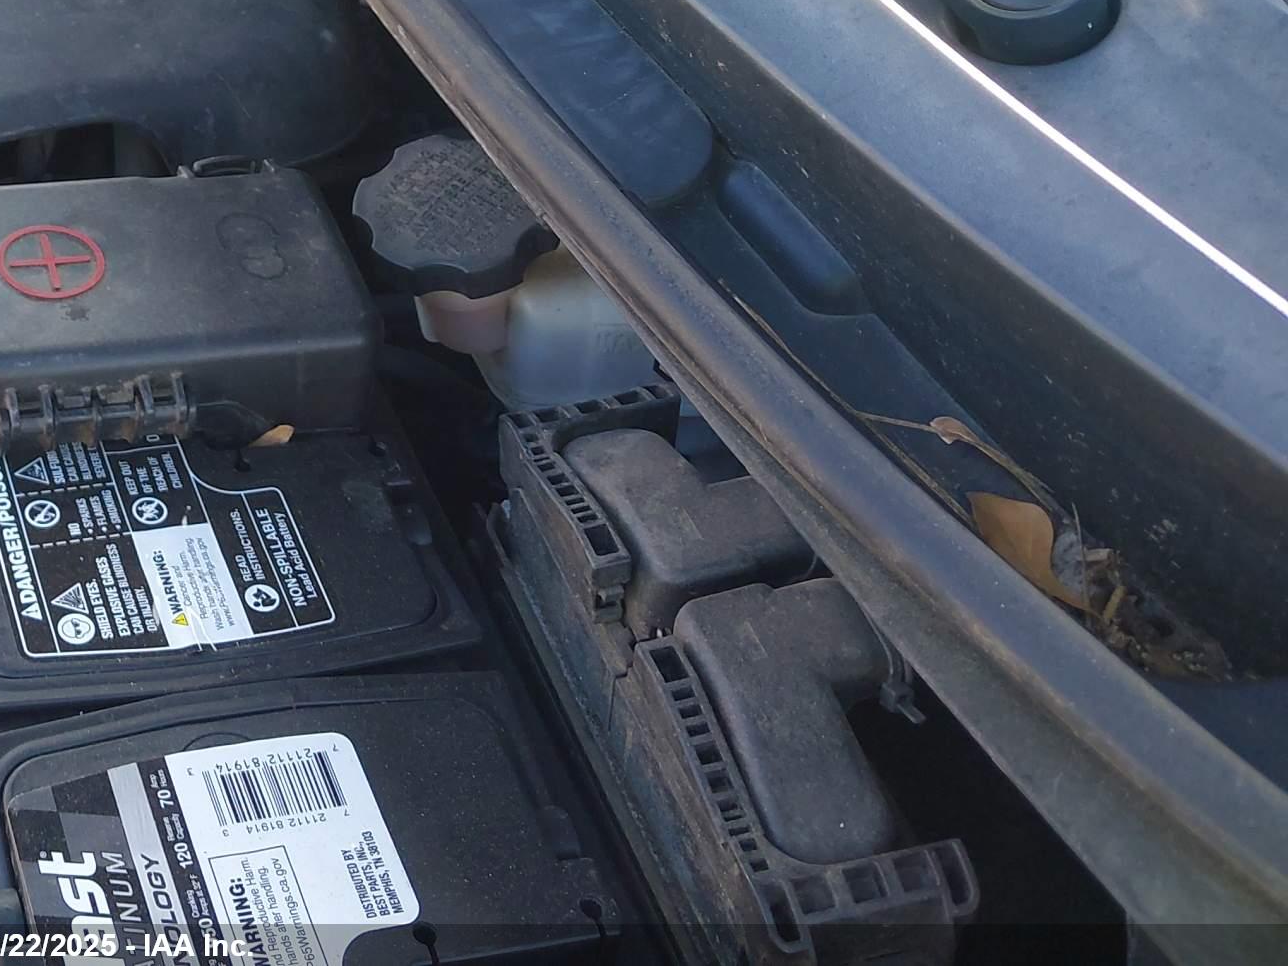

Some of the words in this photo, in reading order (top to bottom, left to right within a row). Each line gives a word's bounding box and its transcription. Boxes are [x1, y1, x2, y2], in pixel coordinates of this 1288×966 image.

[118, 460, 132, 476] OUT
[136, 466, 149, 483] THE
[147, 456, 158, 467] OF
[124, 477, 139, 495] KEEP
[141, 483, 153, 494] OF
[151, 468, 168, 492] REACH
[75, 498, 93, 528] SPARKS
[89, 496, 107, 526] FLAMES
[101, 490, 121, 524] SMOKING
[67, 523, 82, 536] NO
[273, 512, 295, 548] Battery
[230, 509, 265, 580] INSTRUCTIONS.
[255, 508, 307, 607] NON-SPILLABLE
[95, 556, 115, 586] GASES
[106, 544, 129, 587] BLINDNESS
[172, 565, 183, 578] and
[235, 555, 253, 582] READ
[288, 549, 306, 572] Acid
[85, 578, 104, 605] EYES.
[153, 550, 183, 614] WARNING:
[178, 581, 192, 606] Cancer
[298, 574, 318, 599] Lead
[105, 586, 131, 636] EXPLOSIVE
[120, 588, 138, 615] CAUSE
[93, 606, 114, 639] SHIELD
[130, 617, 144, 634] CAN
[144, 618, 158, 632] OR
[157, 789, 174, 809] 70
[174, 842, 194, 869] 120
[341, 849, 354, 861] BY
[362, 831, 380, 856] 38103
[241, 857, 257, 886] Harm.
[372, 857, 385, 869] TN
[258, 866, 278, 909] handling.
[361, 862, 380, 892] PARTS,
[346, 863, 377, 919] DISTRIBUTED
[379, 870, 404, 914] MEMPHIS,
[373, 894, 391, 916] BEST
[251, 888, 279, 951] Reproductive
[272, 912, 287, 933] after
[281, 935, 299, 966] hands
